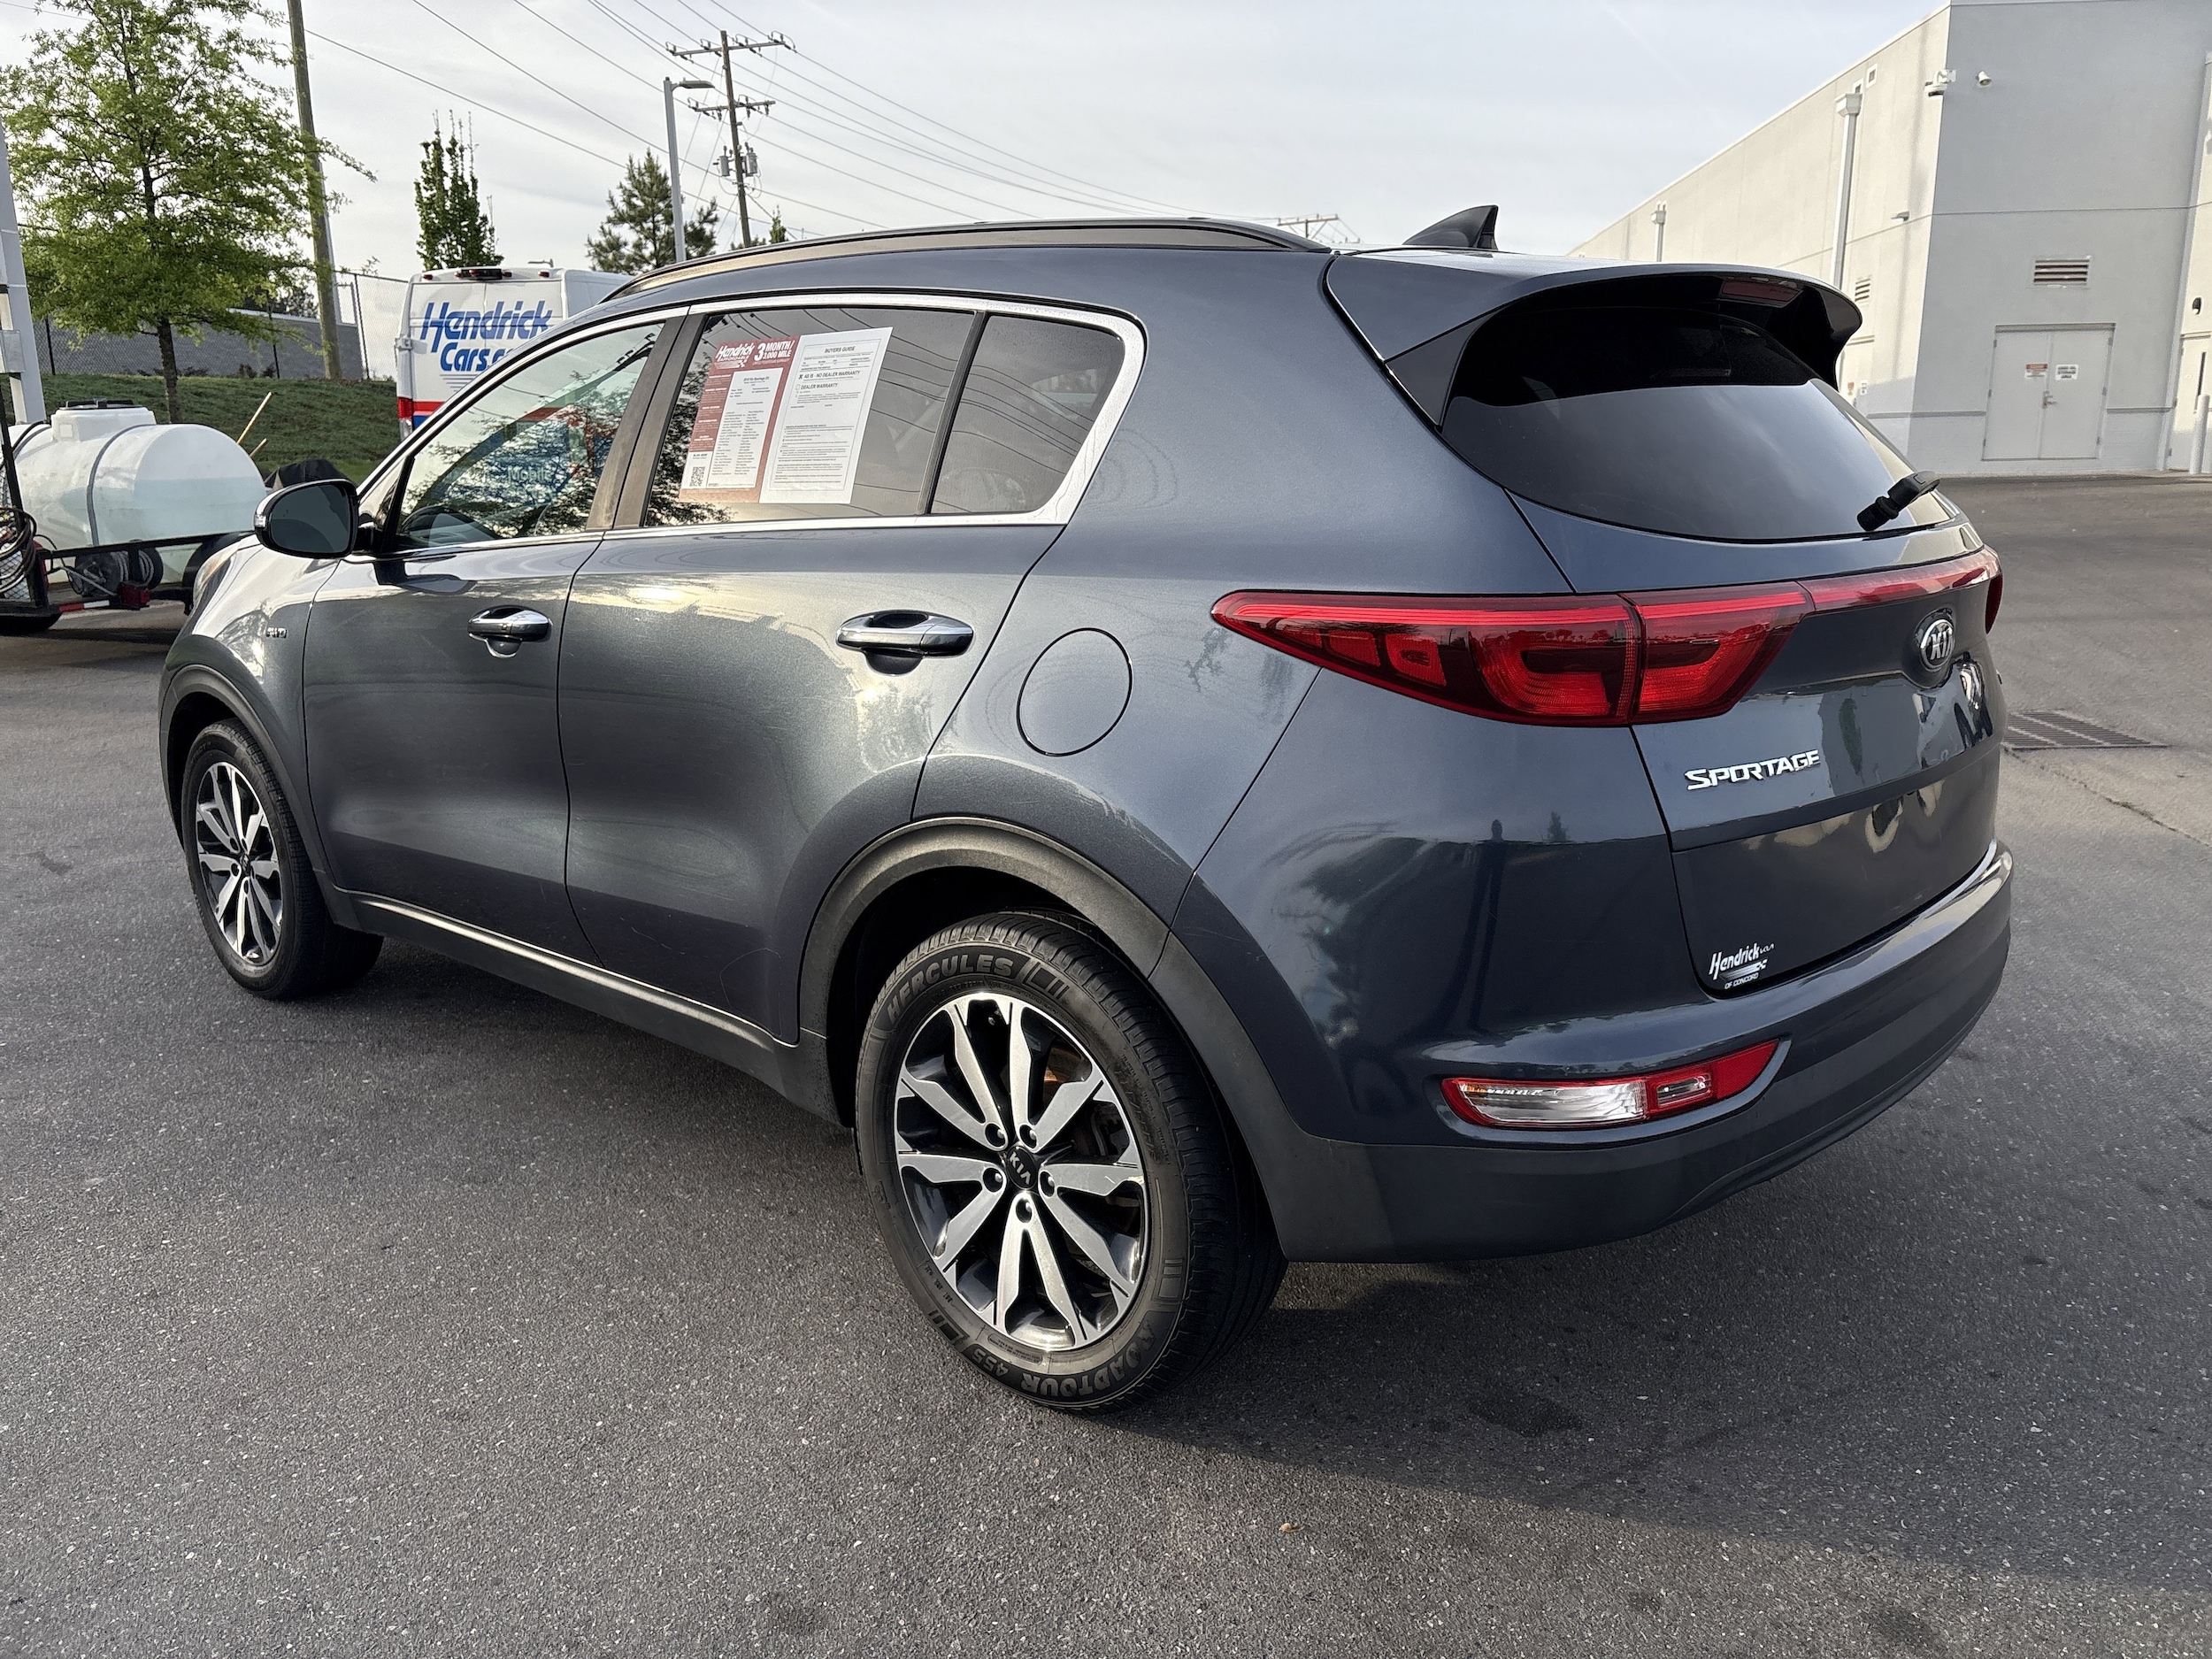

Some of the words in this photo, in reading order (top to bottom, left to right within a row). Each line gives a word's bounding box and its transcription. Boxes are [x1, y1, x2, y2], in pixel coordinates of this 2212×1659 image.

[420, 301, 553, 353] Hendrick
[441, 342, 513, 371] Cars.c
[715, 342, 755, 362] Hendrick
[754, 342, 766, 361] 3
[778, 349, 792, 358] MILE
[507, 465, 552, 482] Mobile
[1685, 749, 1821, 790] SPORTAGE
[1709, 942, 1760, 980] Hendrick
[887, 954, 1014, 1025] HERCULES
[1733, 972, 1759, 987] CONCORD
[1009, 1151, 1031, 1186] KIA
[973, 1348, 1010, 1378] 455
